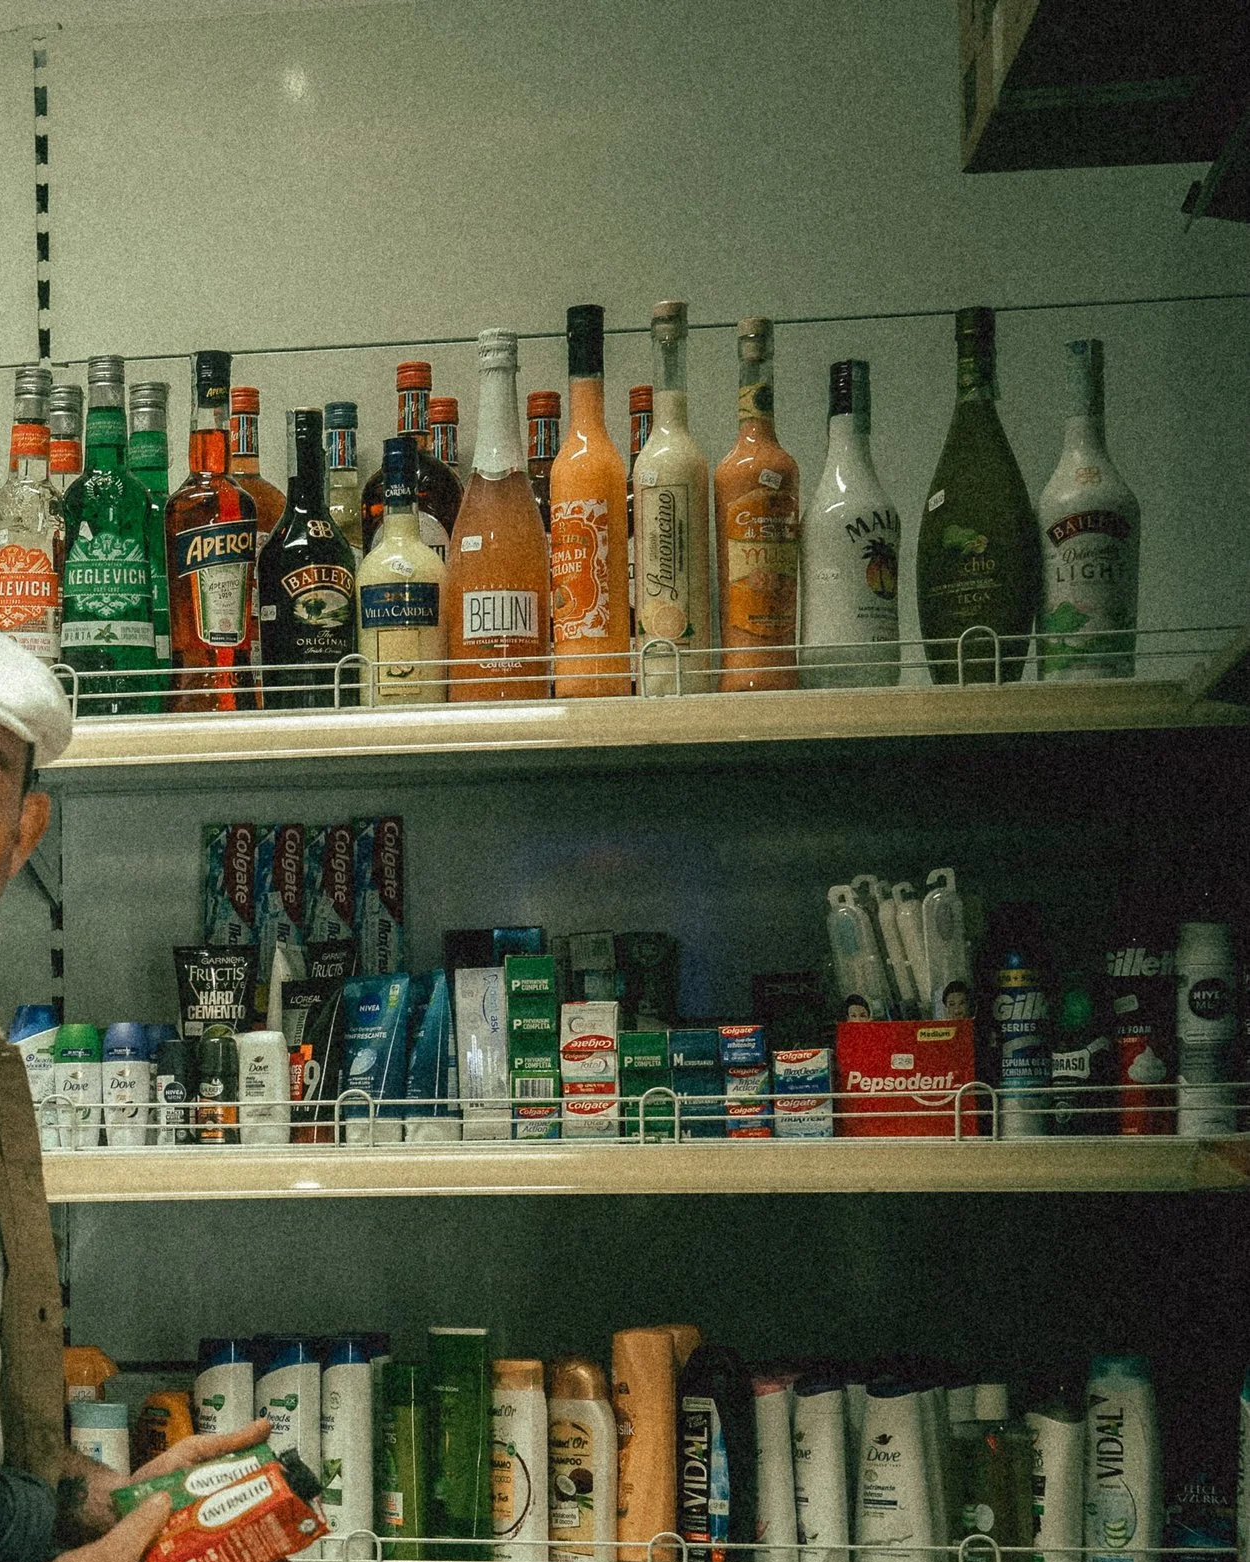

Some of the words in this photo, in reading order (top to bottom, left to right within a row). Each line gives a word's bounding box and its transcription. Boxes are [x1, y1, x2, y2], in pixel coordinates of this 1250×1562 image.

[646, 489, 679, 601] Limoncino
[68, 567, 147, 585] KEGLEVICH
[287, 566, 354, 593] BAILEYS
[469, 596, 532, 633] BELLINI
[296, 637, 348, 647] ORIGINAL
[235, 827, 249, 904] Colgate
[284, 827, 300, 904] Colgate
[336, 829, 351, 903] Colgate
[384, 820, 397, 899] Colgate
[189, 965, 246, 982] FRUCTIS
[199, 990, 235, 1005] HARD
[187, 1004, 246, 1019] CEMENTO
[358, 1004, 380, 1013] NIVEA
[1001, 1022, 1037, 1033] SERIES
[776, 1051, 814, 1062] Colgate
[249, 1061, 270, 1073] Dove
[62, 1079, 90, 1092] Dove
[109, 1077, 136, 1090] Dove
[846, 1070, 956, 1095] Pepsodent
[567, 1100, 610, 1111] Colgate
[1096, 1406, 1124, 1481] VIDAL
[866, 1445, 902, 1463] Dove
[202, 1480, 269, 1522] TAVERNELLO
